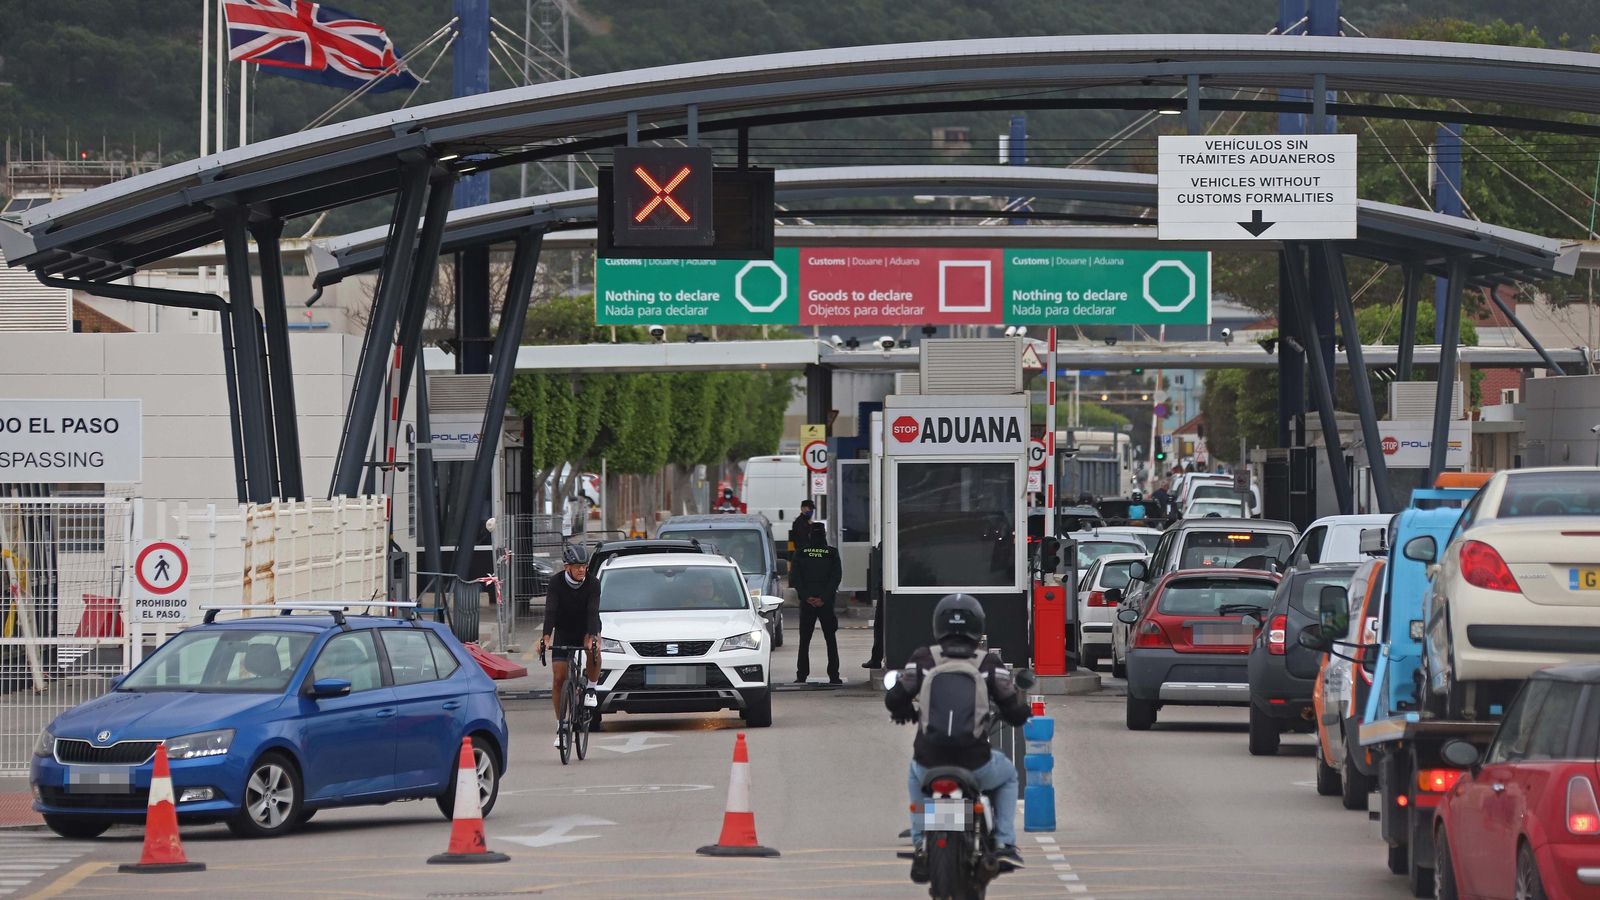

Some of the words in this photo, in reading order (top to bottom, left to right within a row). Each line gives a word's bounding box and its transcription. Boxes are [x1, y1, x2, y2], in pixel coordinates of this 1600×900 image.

[1205, 138, 1282, 150] VEHÍCULOS
[1286, 140, 1308, 150] SIN
[1178, 152, 1246, 164] TRÁMITES
[1250, 154, 1336, 164] ADUANEROS
[1191, 177, 1256, 187] VEHICLES
[1260, 176, 1320, 187] WITHOUT
[1177, 194, 1242, 204] CUSTOMS
[1246, 192, 1334, 203] FORMALITIES
[808, 257, 846, 266] Customs
[852, 258, 882, 266] Douane
[889, 257, 920, 266] Aduana
[1012, 257, 1050, 266] Customs
[1056, 257, 1087, 266] Douane
[1094, 257, 1124, 266] Aduana
[605, 290, 655, 304] Nothing
[658, 292, 672, 302] to
[675, 290, 720, 302] declare
[808, 290, 848, 301] Goods
[851, 292, 865, 301] to
[868, 289, 913, 301] declare
[1012, 290, 1063, 304] Nothing
[1066, 292, 1080, 301] to
[1083, 289, 1128, 301] declare
[605, 305, 634, 316] Nada
[637, 306, 662, 318] para
[665, 304, 708, 316] declarar
[808, 304, 850, 318] Objetos
[854, 306, 878, 318] para
[881, 304, 925, 316] declarar
[1012, 304, 1041, 316] Nada
[1045, 306, 1070, 318] para
[1073, 304, 1116, 316] declarar
[29, 418, 55, 434] EL
[62, 418, 119, 434] PASO
[894, 426, 917, 434] STOP
[920, 416, 1022, 443] ADUANA
[1381, 441, 1398, 450] STOP
[0, 451, 104, 468] SPASSING
[810, 449, 828, 463] 10
